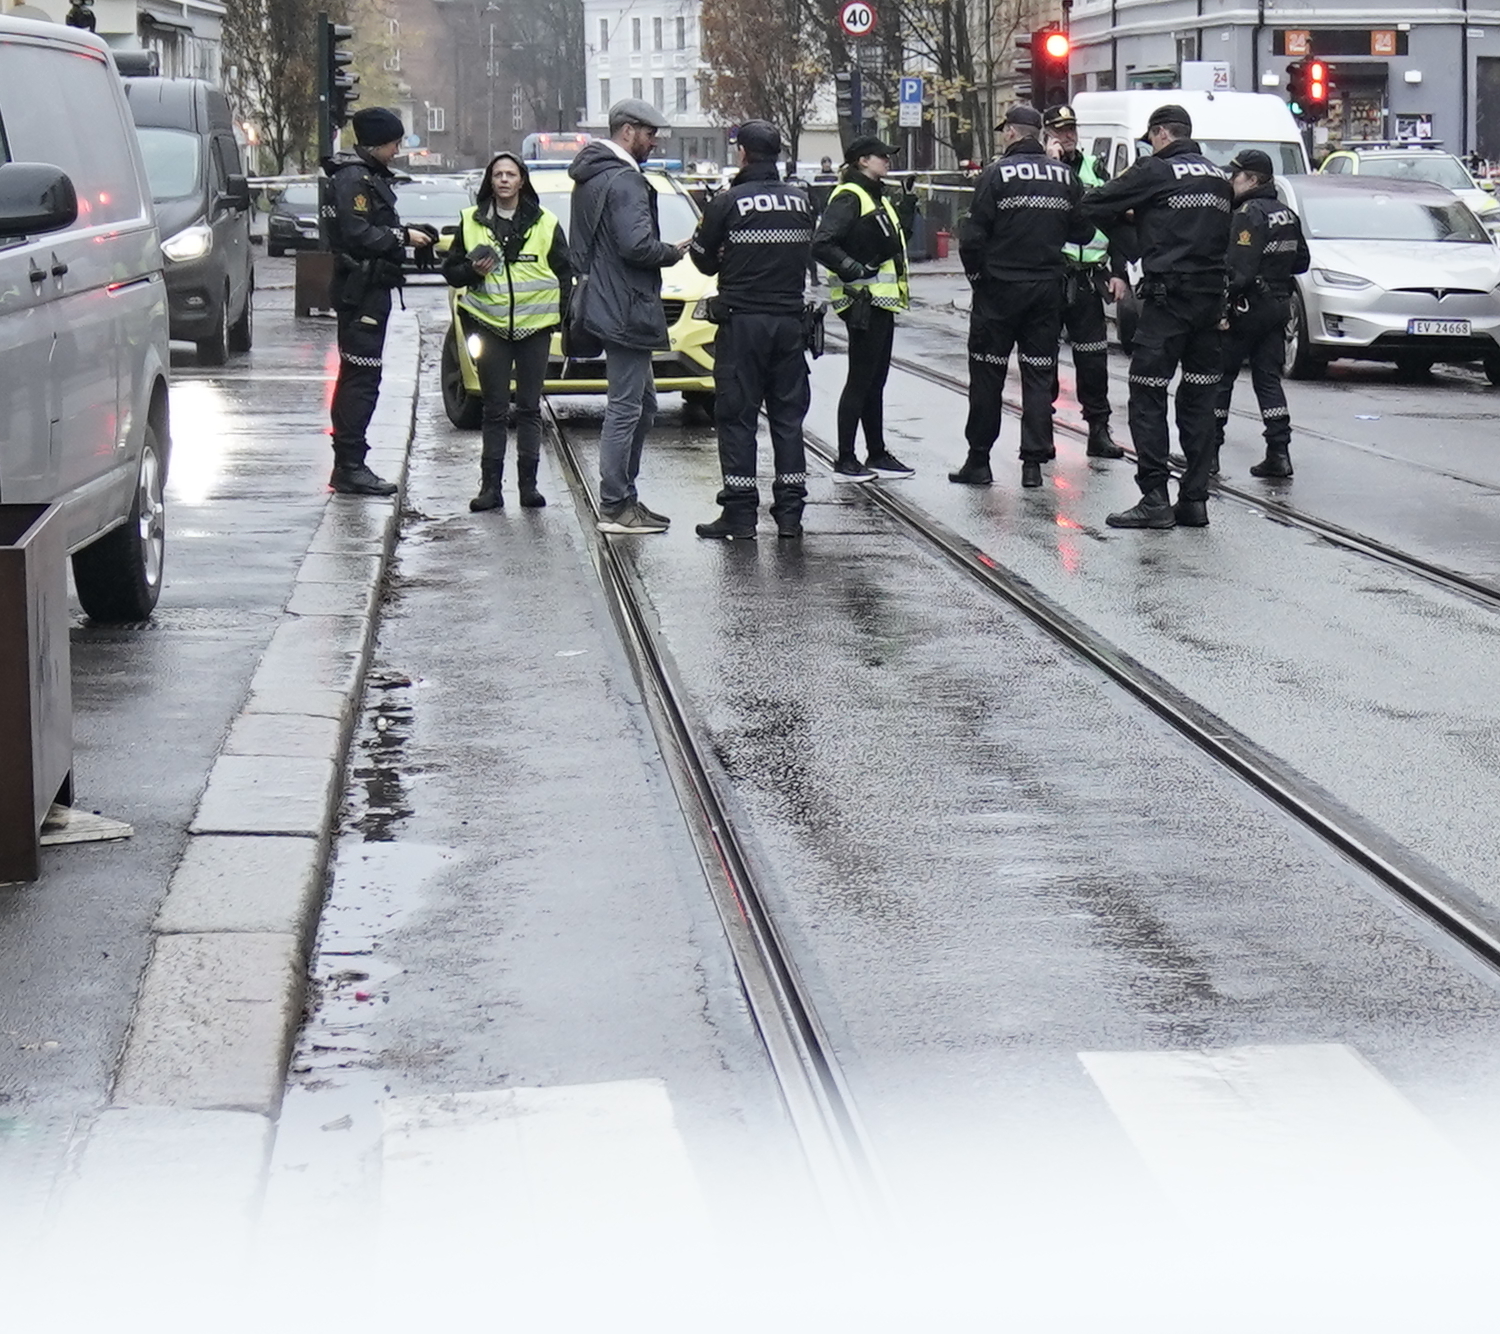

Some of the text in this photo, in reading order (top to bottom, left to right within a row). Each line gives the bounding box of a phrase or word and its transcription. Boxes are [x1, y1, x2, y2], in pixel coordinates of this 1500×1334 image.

[846, 9, 869, 27] 40
[1214, 72, 1227, 83] 24
[905, 81, 918, 100] P
[1000, 165, 1071, 185] POLITI
[1417, 323, 1468, 334] EV 24668
